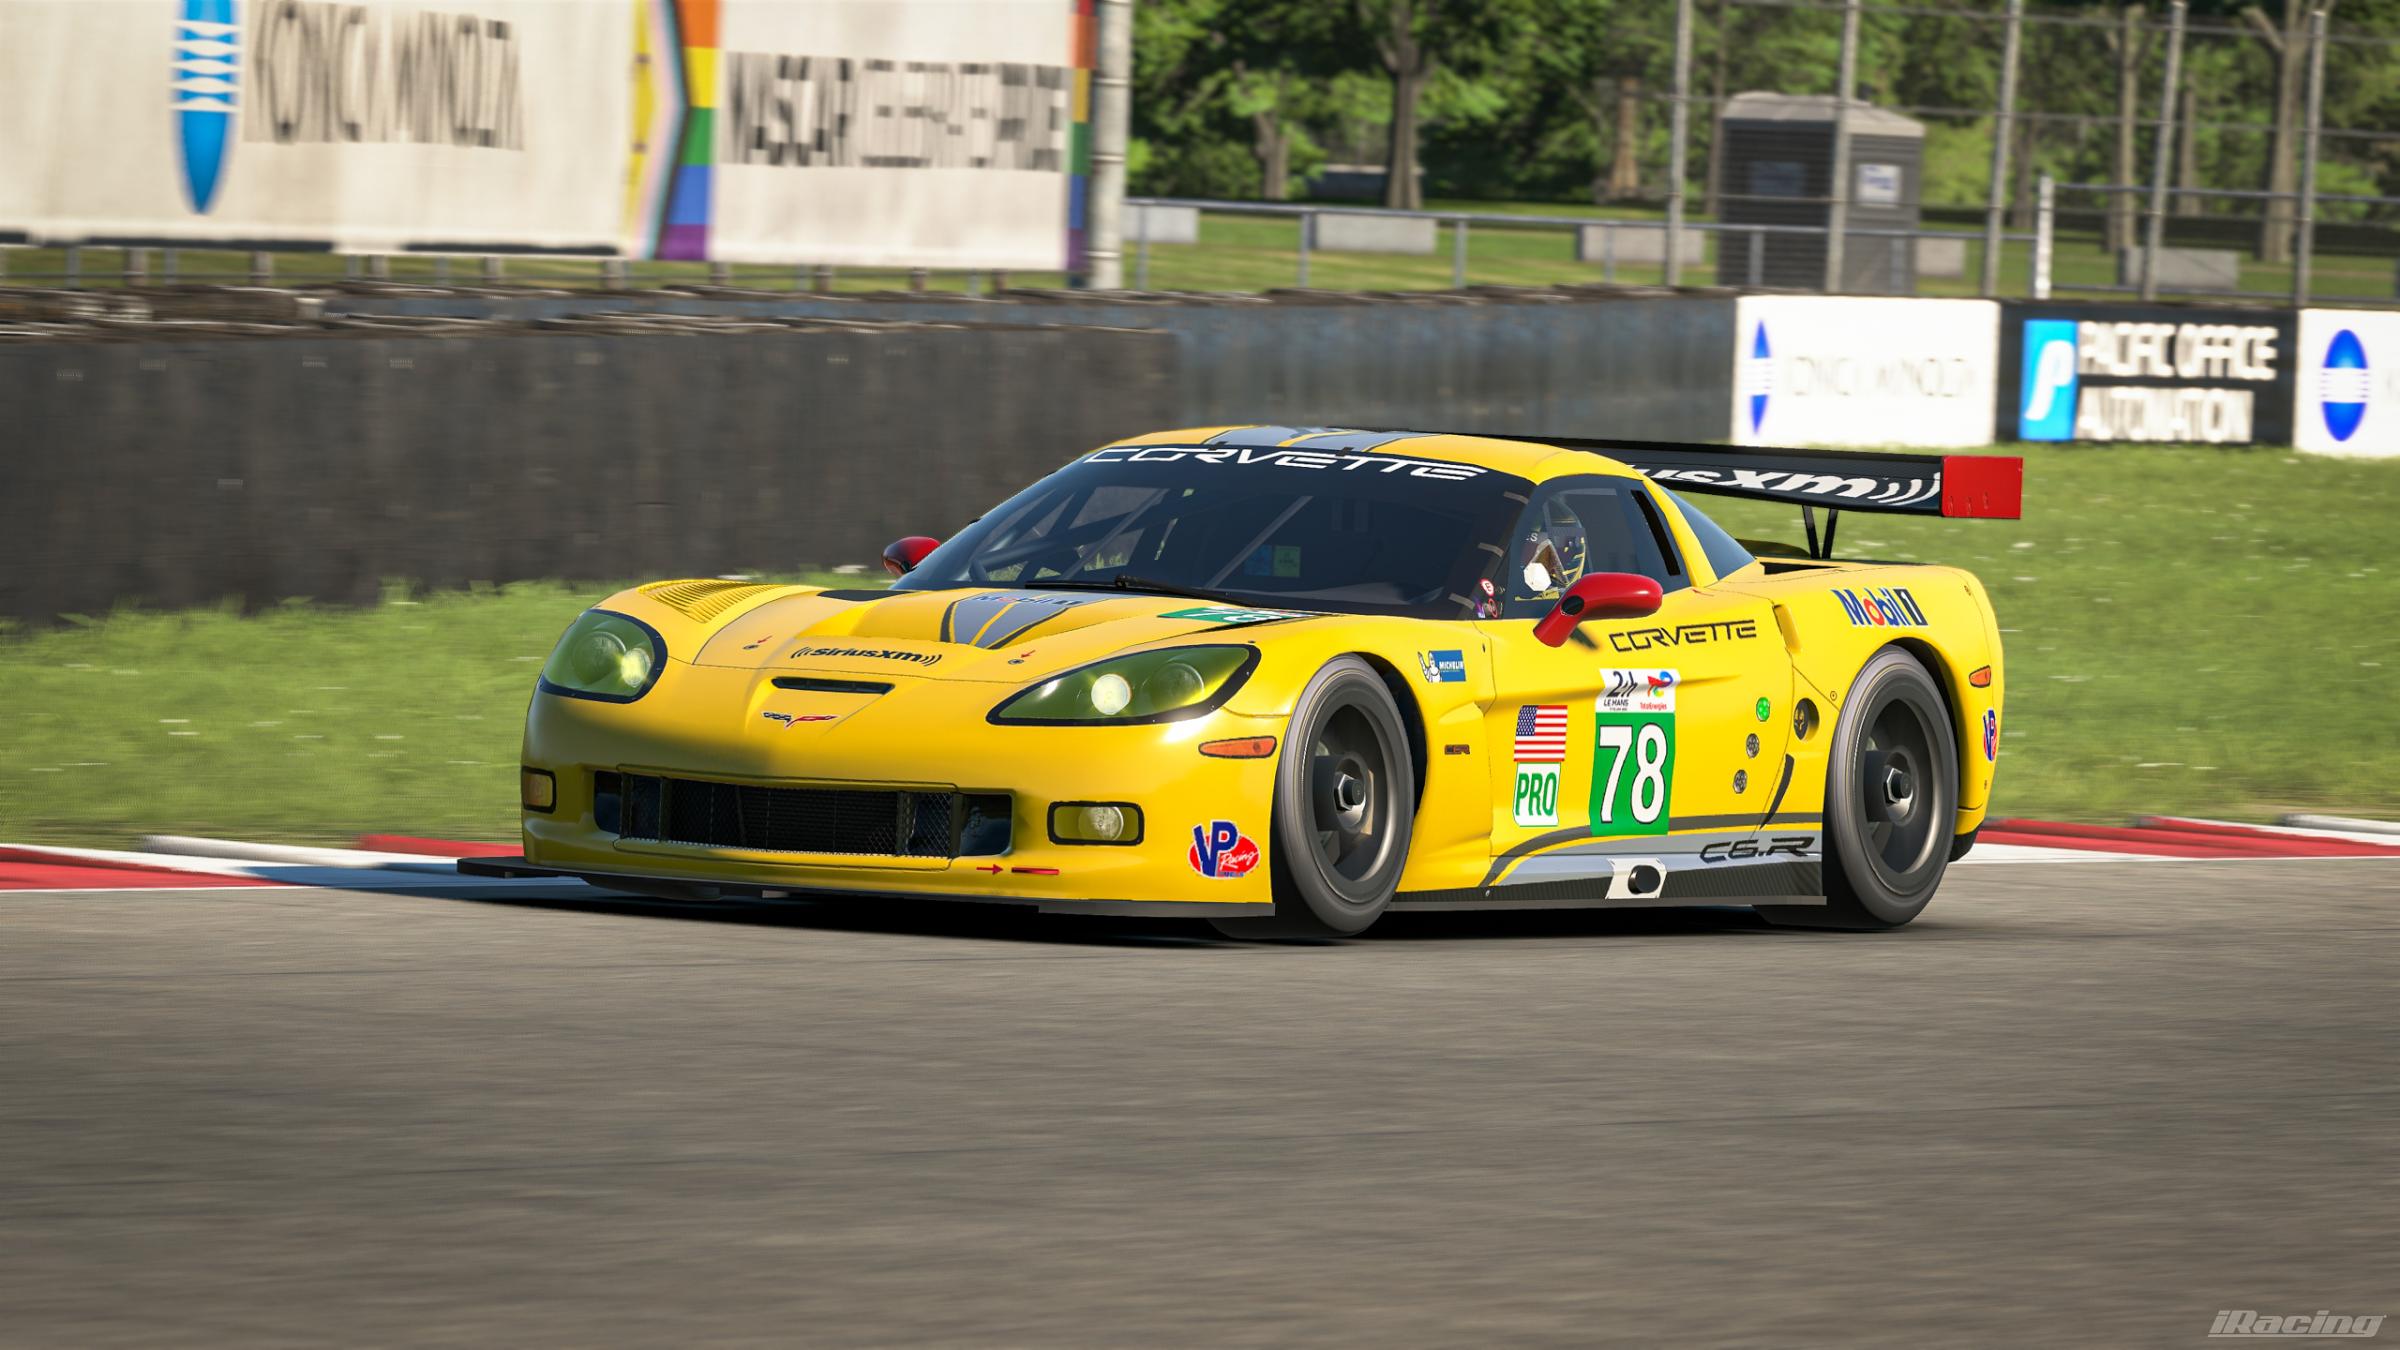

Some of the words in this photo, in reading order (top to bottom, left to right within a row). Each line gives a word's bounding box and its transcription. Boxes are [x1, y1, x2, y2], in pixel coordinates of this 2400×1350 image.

[2176, 323, 2279, 380] OFFICE
[1084, 447, 1488, 480] CORVETTE
[1831, 588, 1911, 626] Mobil
[1897, 590, 1926, 625] 1
[1608, 619, 1757, 652] CORVETTE
[1599, 722, 1668, 825] 78
[1516, 772, 1557, 816] PRO
[1193, 821, 1238, 877] VP
[1219, 850, 1259, 870] Racing
[1700, 837, 1815, 864] C6.R
